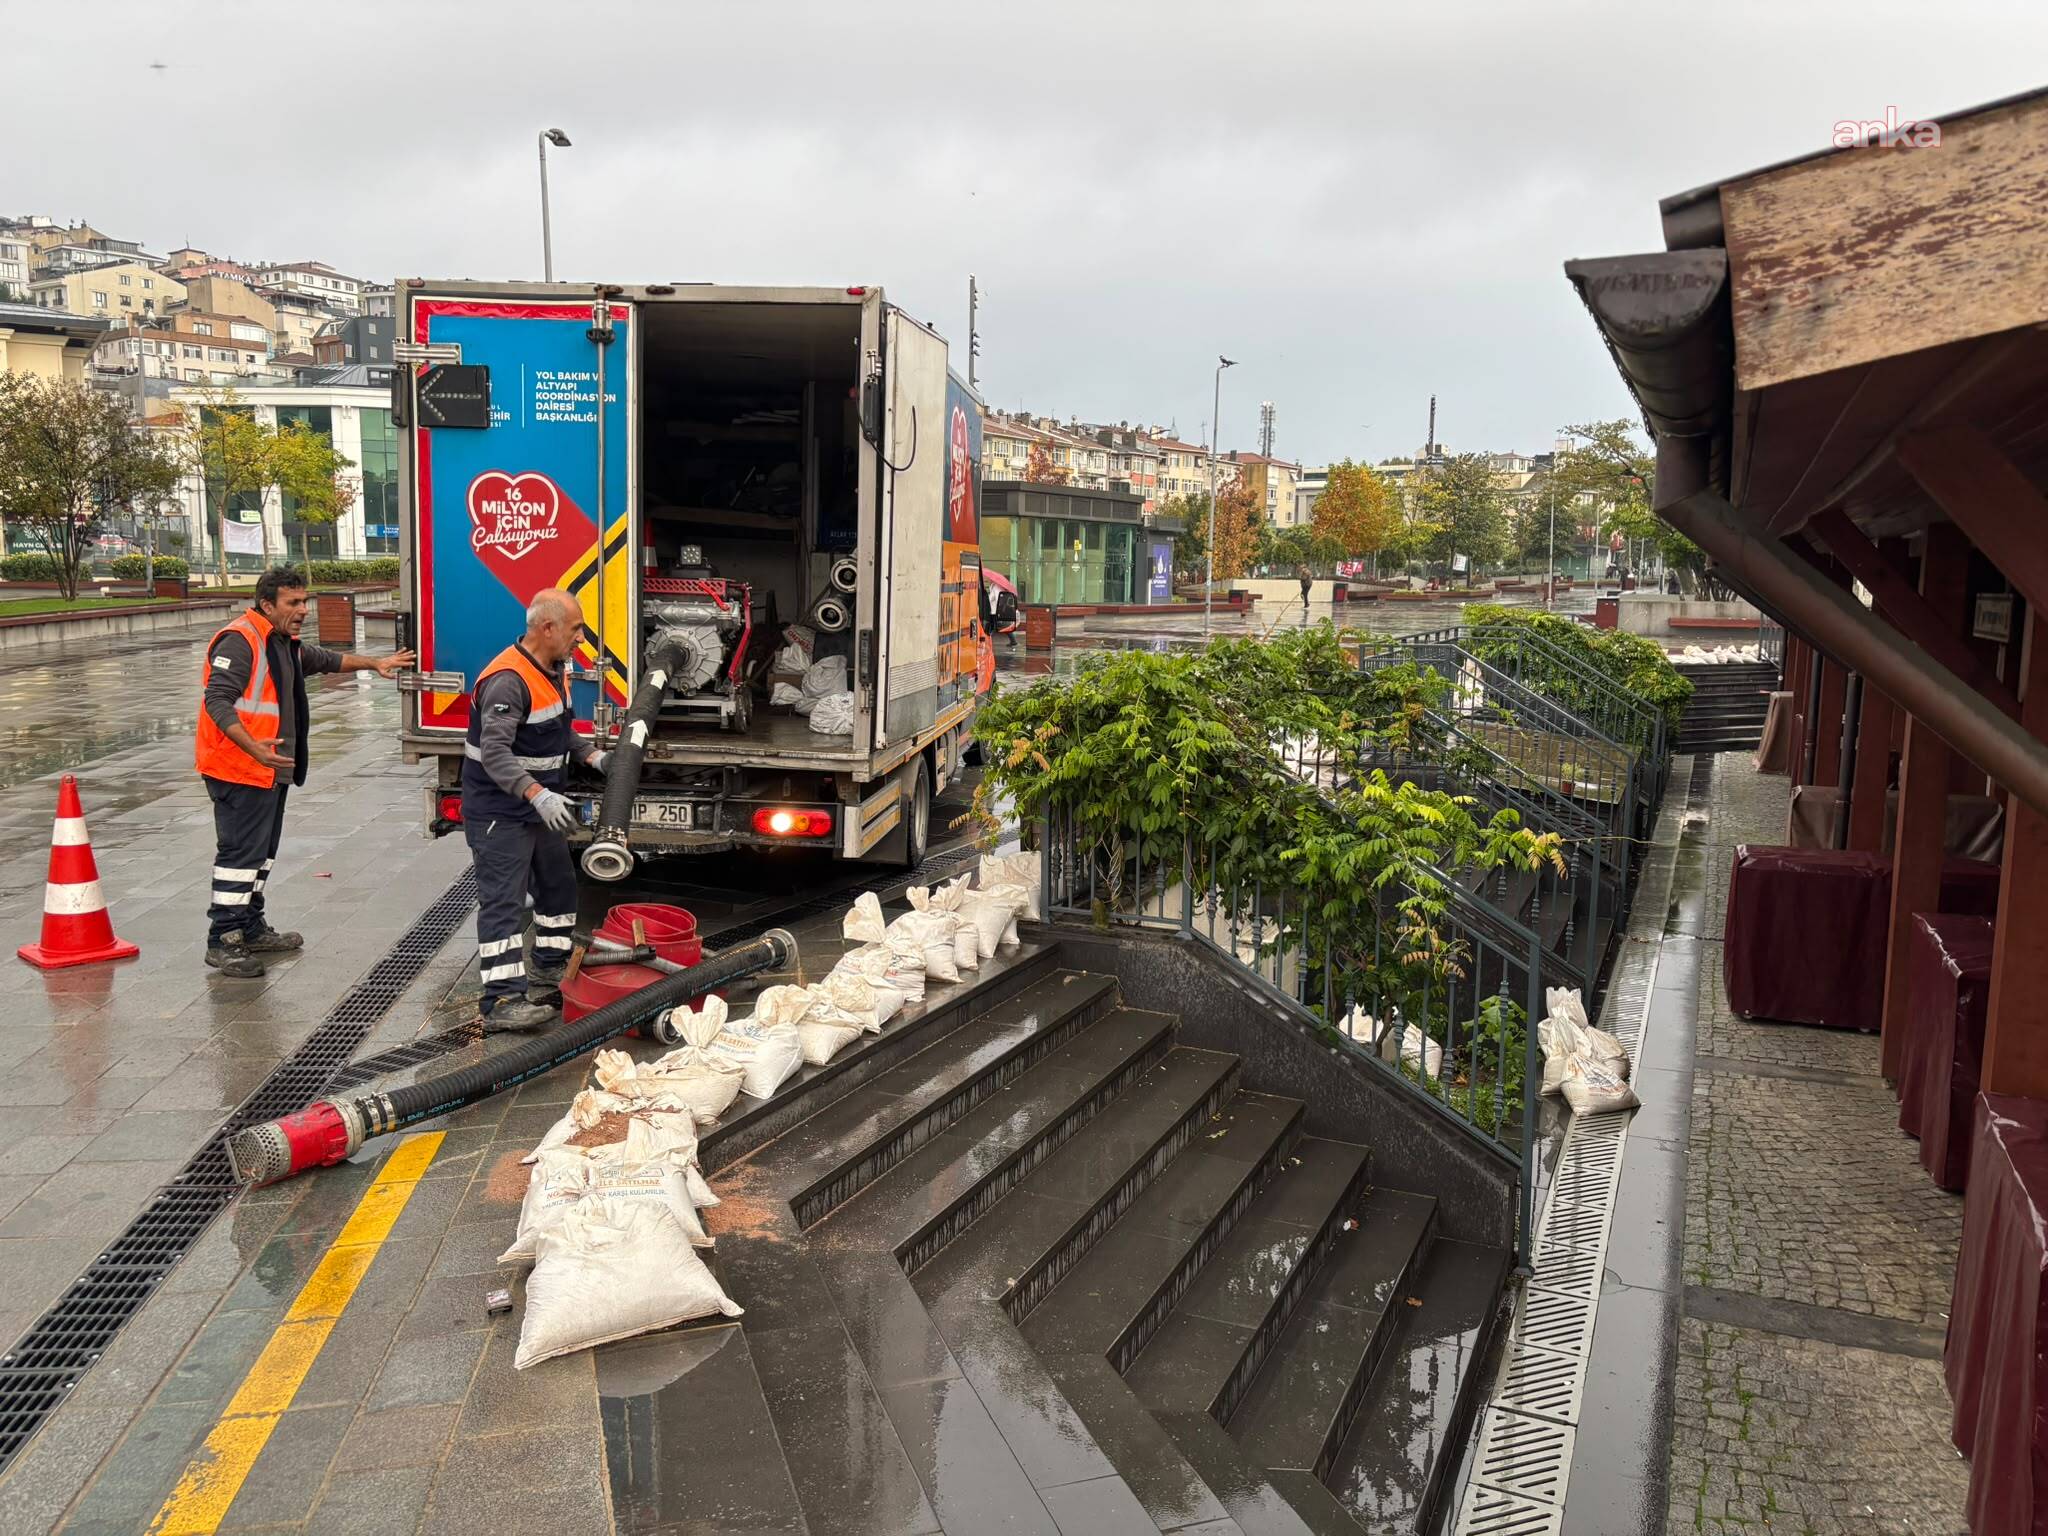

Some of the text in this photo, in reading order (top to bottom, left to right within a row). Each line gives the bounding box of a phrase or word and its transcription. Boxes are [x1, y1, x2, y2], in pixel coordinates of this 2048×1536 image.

[536, 371, 605, 381] YOL BAKIM V
[536, 381, 577, 391] ALTYAPI
[536, 401, 575, 411] DAİRESİ
[536, 412, 597, 423] BAŞKANLIĞI
[505, 487, 522, 501] 16
[472, 526, 558, 552] Çalışıyoruz
[658, 805, 688, 823] 250
